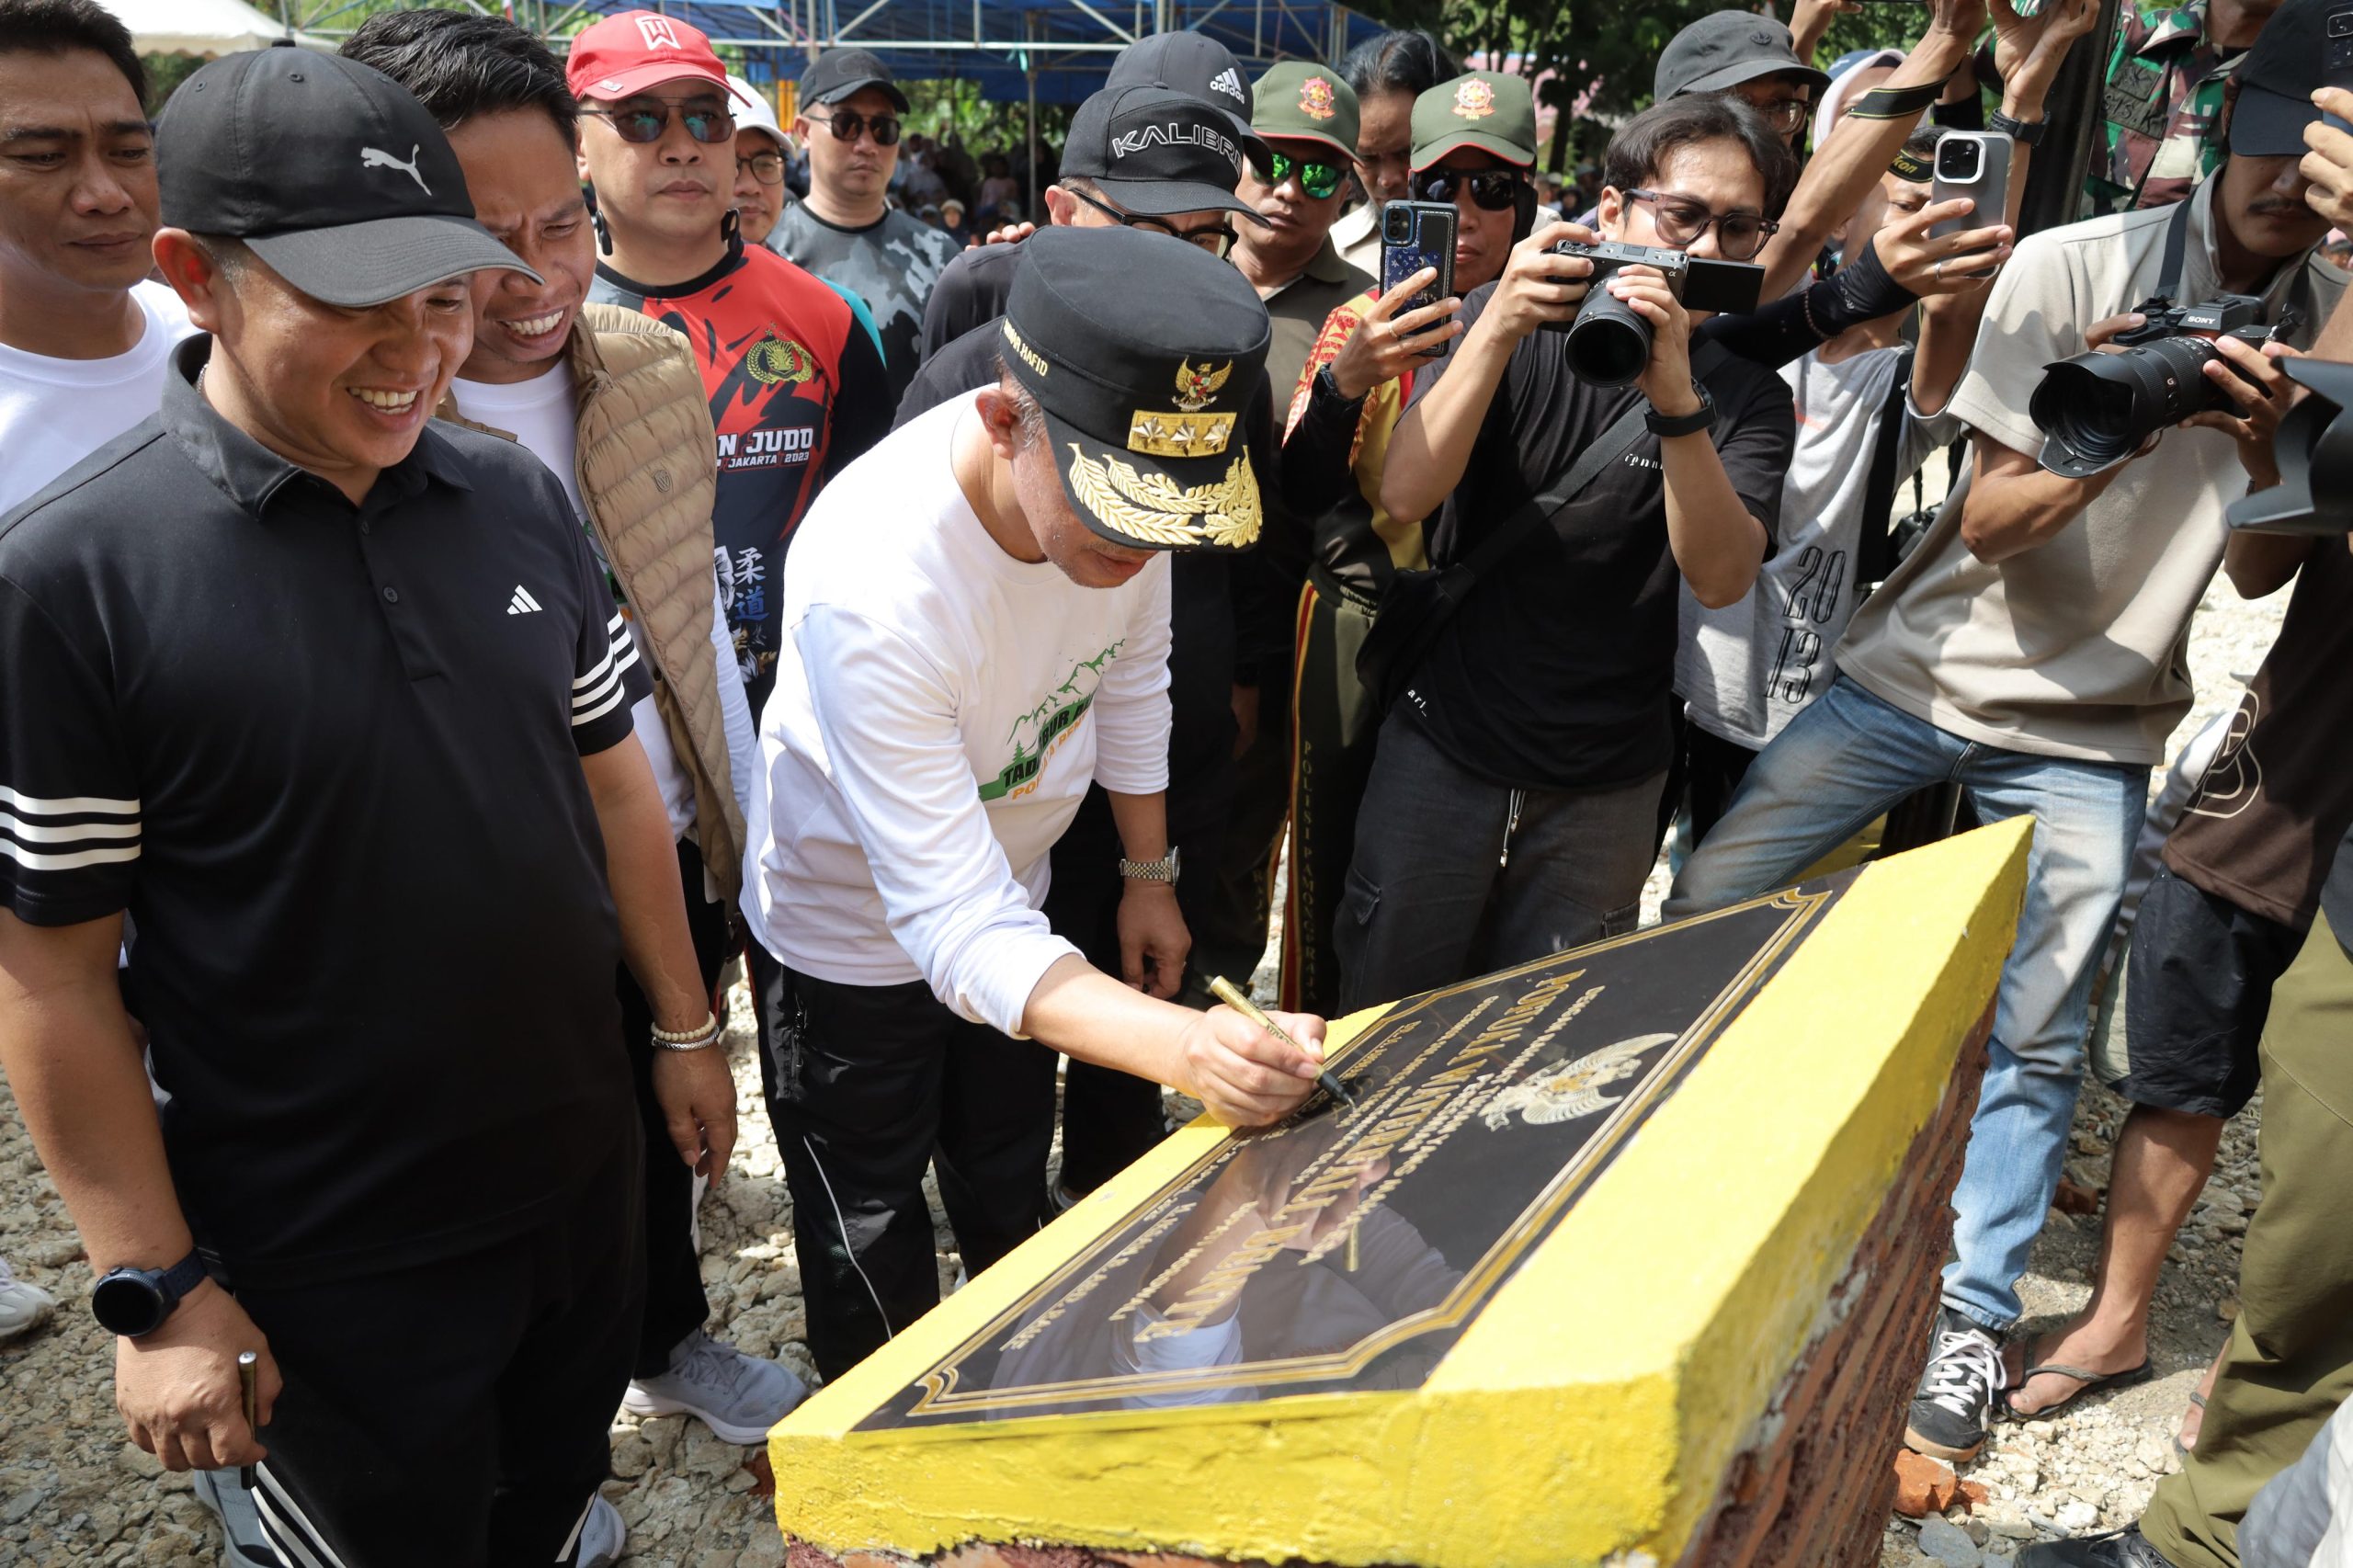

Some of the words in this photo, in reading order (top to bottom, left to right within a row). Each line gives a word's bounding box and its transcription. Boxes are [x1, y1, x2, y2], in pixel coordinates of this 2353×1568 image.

[1210, 80, 1245, 104] adidas
[1893, 155, 1918, 174] kon
[2188, 315, 2216, 324] SONY
[1019, 342, 1048, 377] HAFID
[718, 433, 738, 457] N
[745, 427, 813, 454] JUDO
[727, 454, 778, 469] JAKARTA
[783, 450, 810, 463] 2023
[734, 546, 770, 622] 柔道
[1783, 545, 1847, 624] 20
[1764, 626, 1822, 704] 13
[1302, 740, 1313, 840] POLISI
[1436, 994, 1501, 1042] GUBERNUR
[1445, 969, 1587, 1066] POFUA'A
[1542, 983, 1606, 1034] DENGAN
[1382, 1039, 1448, 1087] SULAWESI
[1486, 1032, 1555, 1087] RAHMAT
[1326, 1085, 1413, 1152] DIRESMIKAN
[1332, 1085, 1394, 1130] TENGAH
[1396, 1072, 1495, 1153] PERESMIAN
[1435, 1085, 1501, 1135] TUHAN
[1269, 1058, 1491, 1221] WATERFALL
[1390, 1133, 1450, 1178] YANG
[1288, 1150, 1337, 1186] OLEH
[1193, 1199, 1260, 1247] BUPATI
[1335, 1176, 1404, 1228] MAHA
[1295, 1228, 1351, 1266] ESA
[1106, 1245, 1207, 1322] MOROWALI
[1131, 1223, 1307, 1342] BENTE
